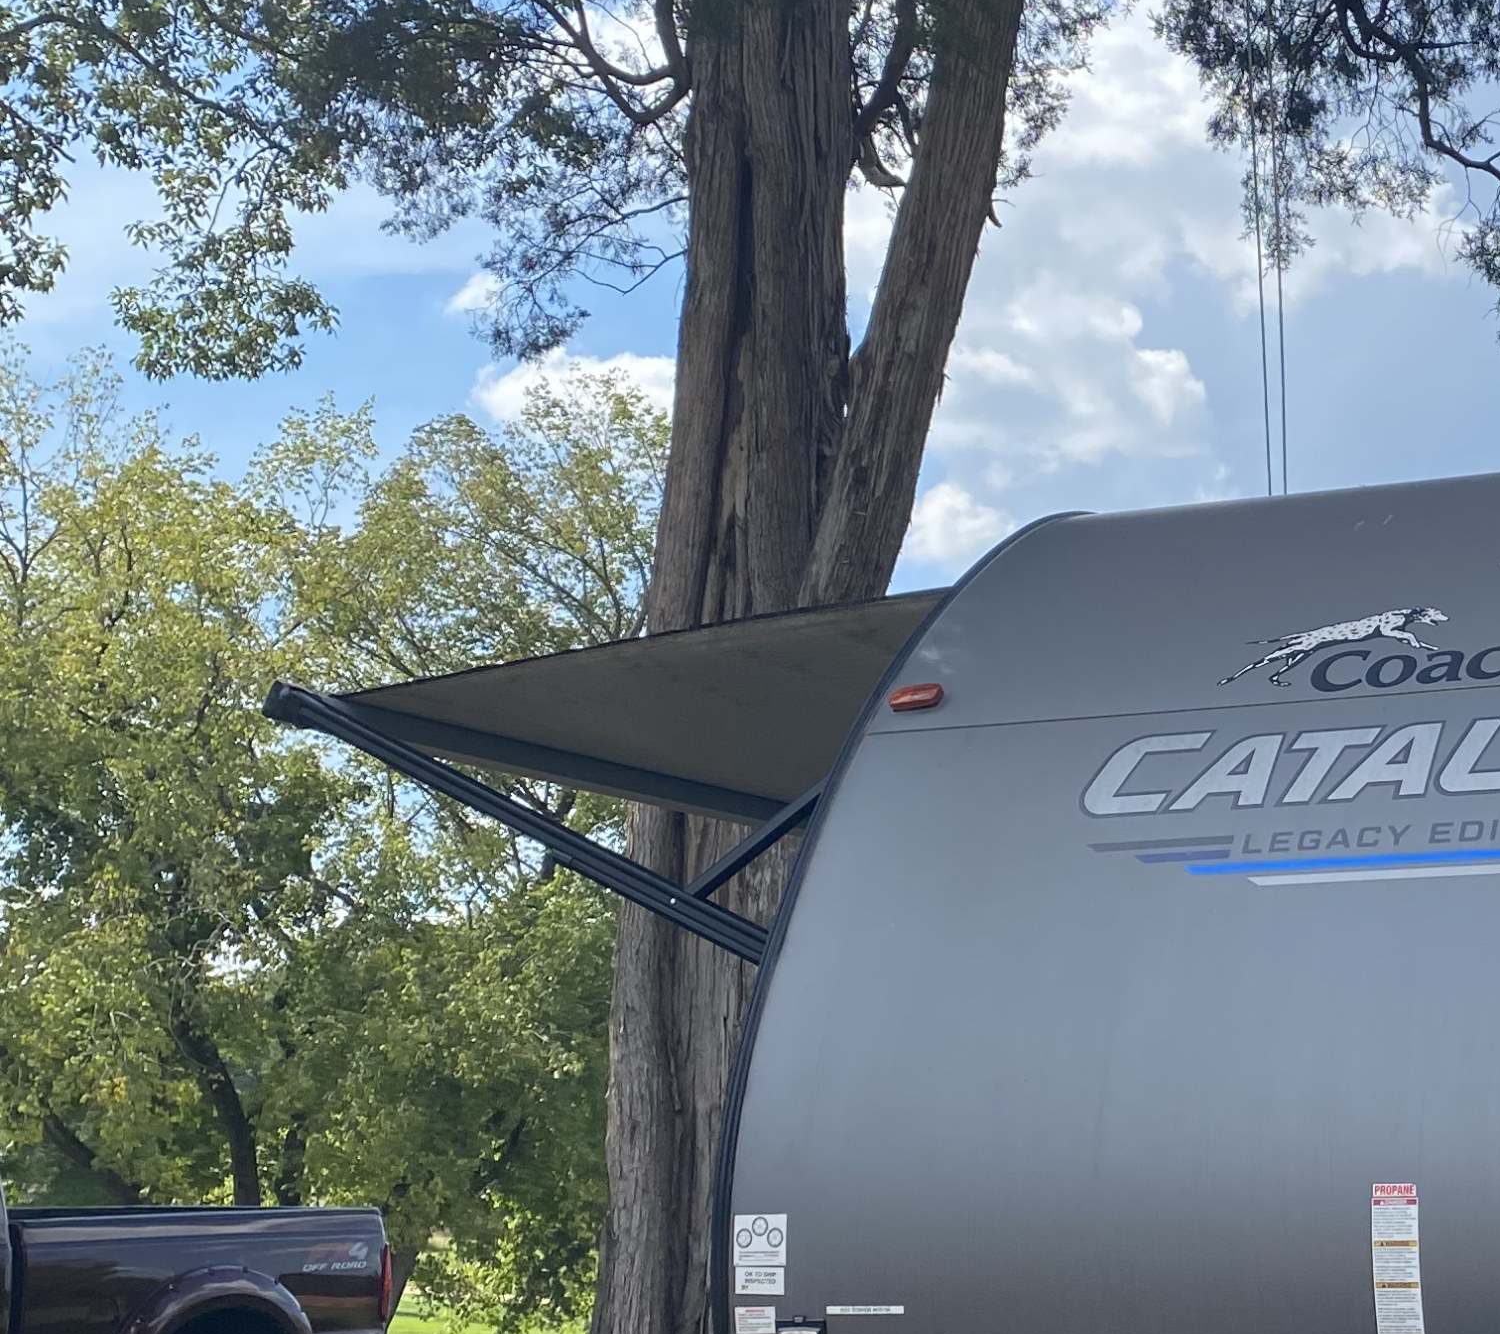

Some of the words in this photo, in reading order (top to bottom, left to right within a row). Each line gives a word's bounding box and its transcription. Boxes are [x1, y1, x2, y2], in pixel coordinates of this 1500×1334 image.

[1240, 822, 1412, 856] LEGACY
[1374, 1185, 1414, 1196] PROPANE
[302, 1262, 329, 1272] OFF
[331, 1260, 367, 1270] ROAD
